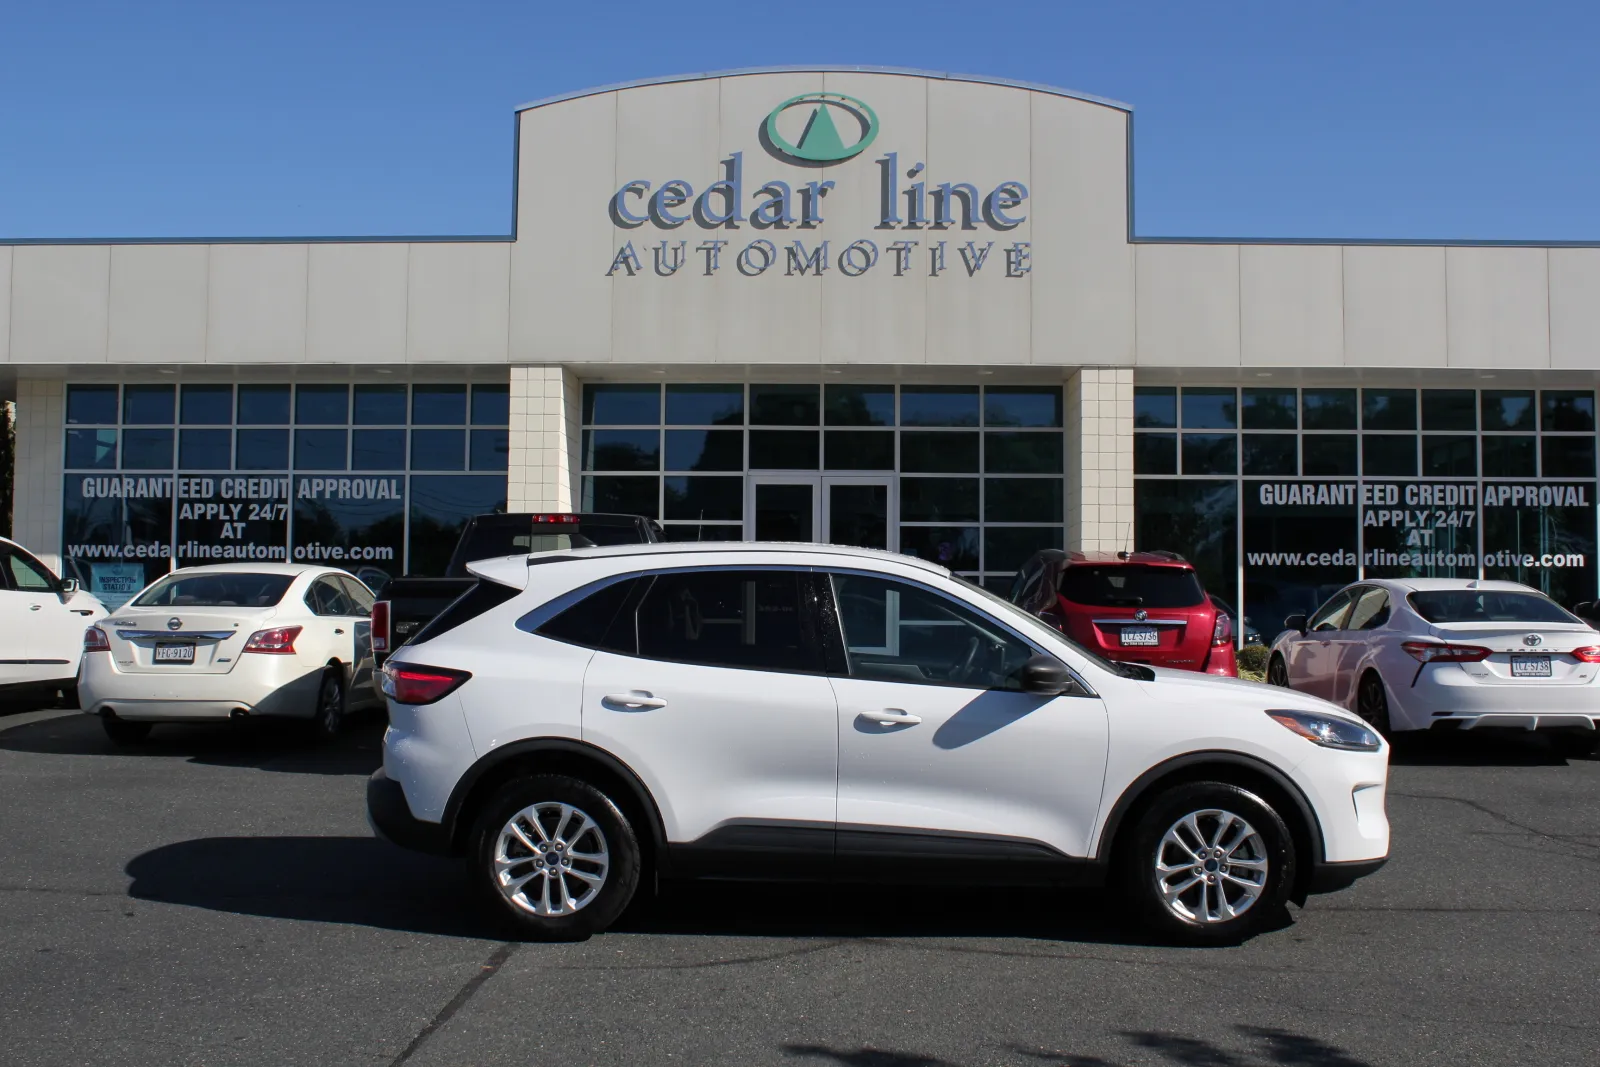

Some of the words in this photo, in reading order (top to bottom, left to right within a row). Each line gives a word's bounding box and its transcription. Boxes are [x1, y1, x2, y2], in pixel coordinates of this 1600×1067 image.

[612, 151, 835, 228] cedar
[875, 151, 1029, 228] line
[608, 239, 1032, 275] AUTOMOTIVE
[82, 477, 214, 498] GUARANTEED
[220, 478, 289, 499] CREDIT
[298, 479, 401, 500] APPROVAL
[1260, 484, 1399, 505] GUARANTEED
[1405, 484, 1477, 506] CREDIT
[1484, 485, 1589, 507] APPROVAL
[179, 503, 243, 521] APPLY
[248, 504, 288, 521] 24/7
[1363, 510, 1429, 527] APPLY
[1435, 510, 1476, 528] 24/7
[220, 522, 246, 539] AT
[1406, 529, 1434, 546] AT
[68, 541, 393, 560] www.cedarlineautomotive.com
[1247, 548, 1584, 567] www.cedarlineautomotive.com
